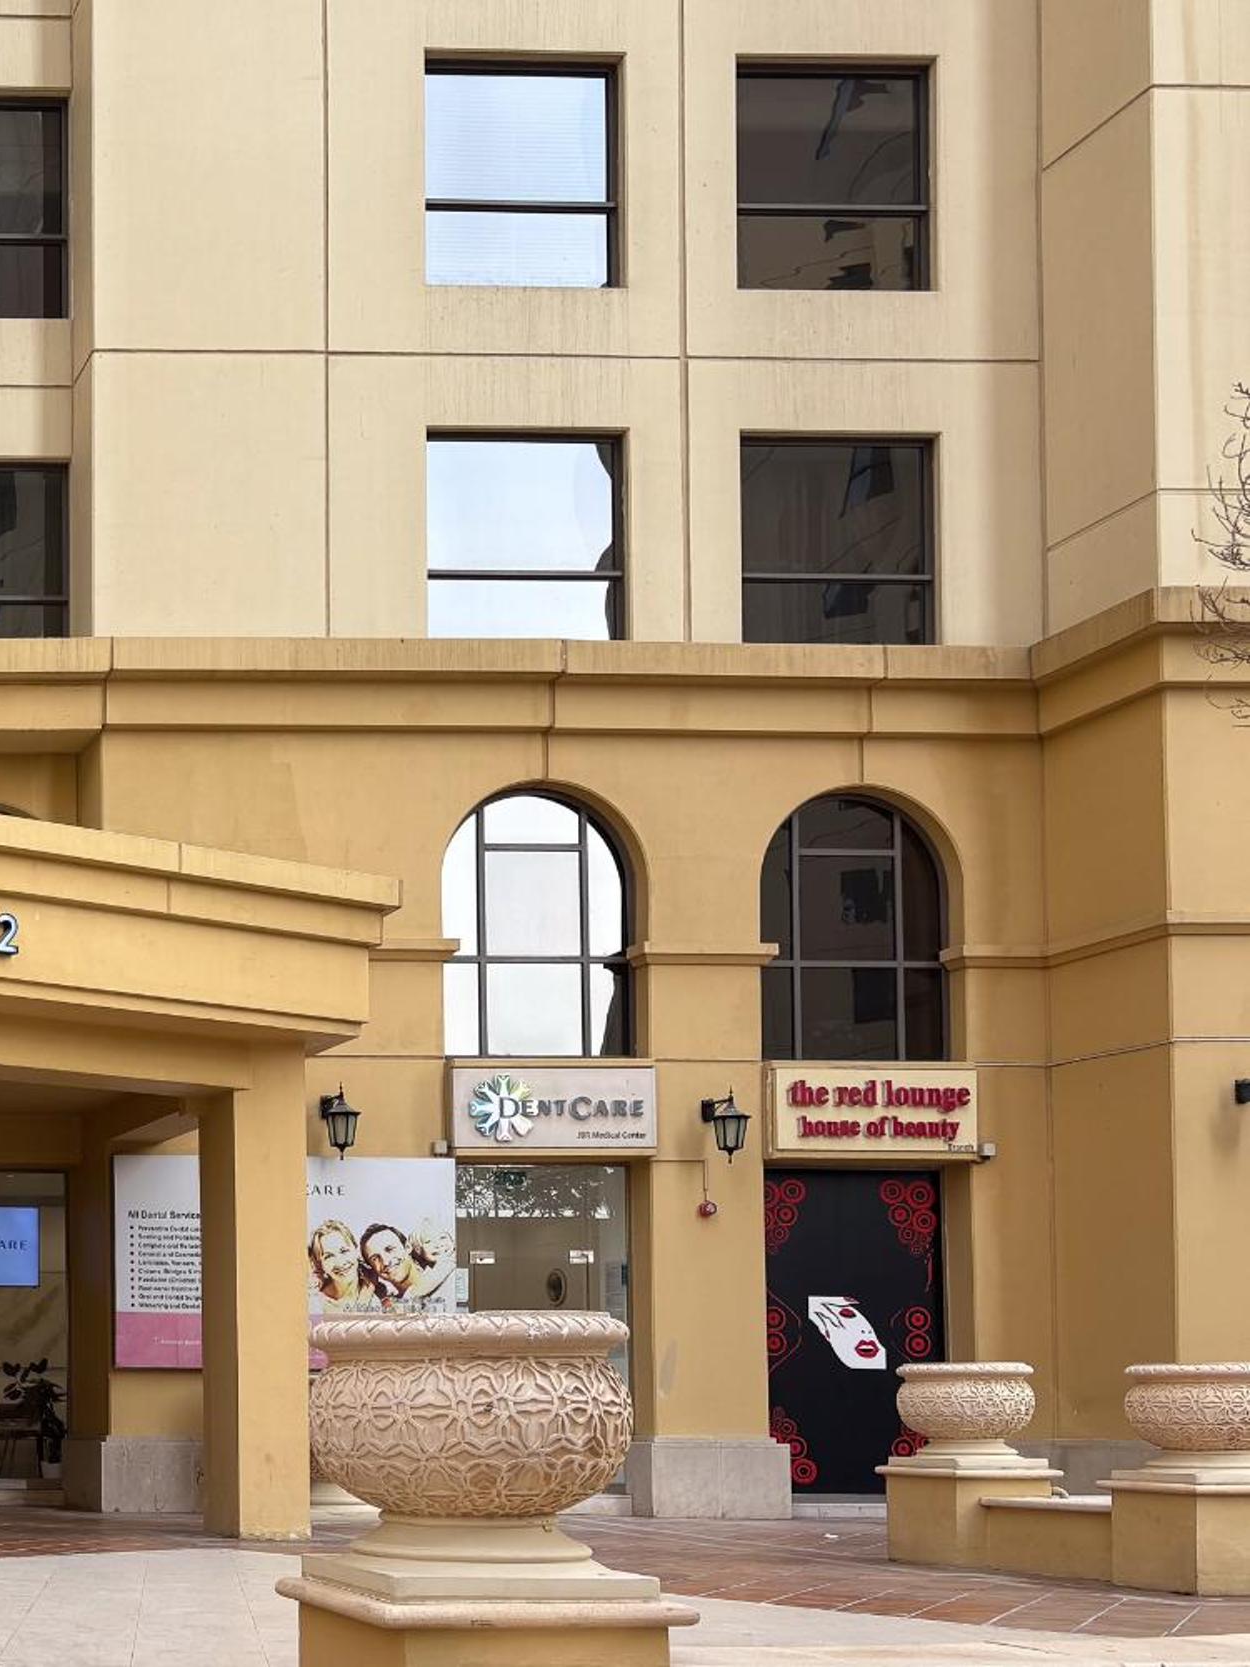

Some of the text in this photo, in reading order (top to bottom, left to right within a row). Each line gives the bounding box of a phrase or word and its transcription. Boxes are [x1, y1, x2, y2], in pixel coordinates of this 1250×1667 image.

[788, 1080, 971, 1114] the red lounge
[591, 1131, 621, 1139] Medical
[622, 1131, 647, 1139] Center
[798, 1116, 960, 1143] house of beauty
